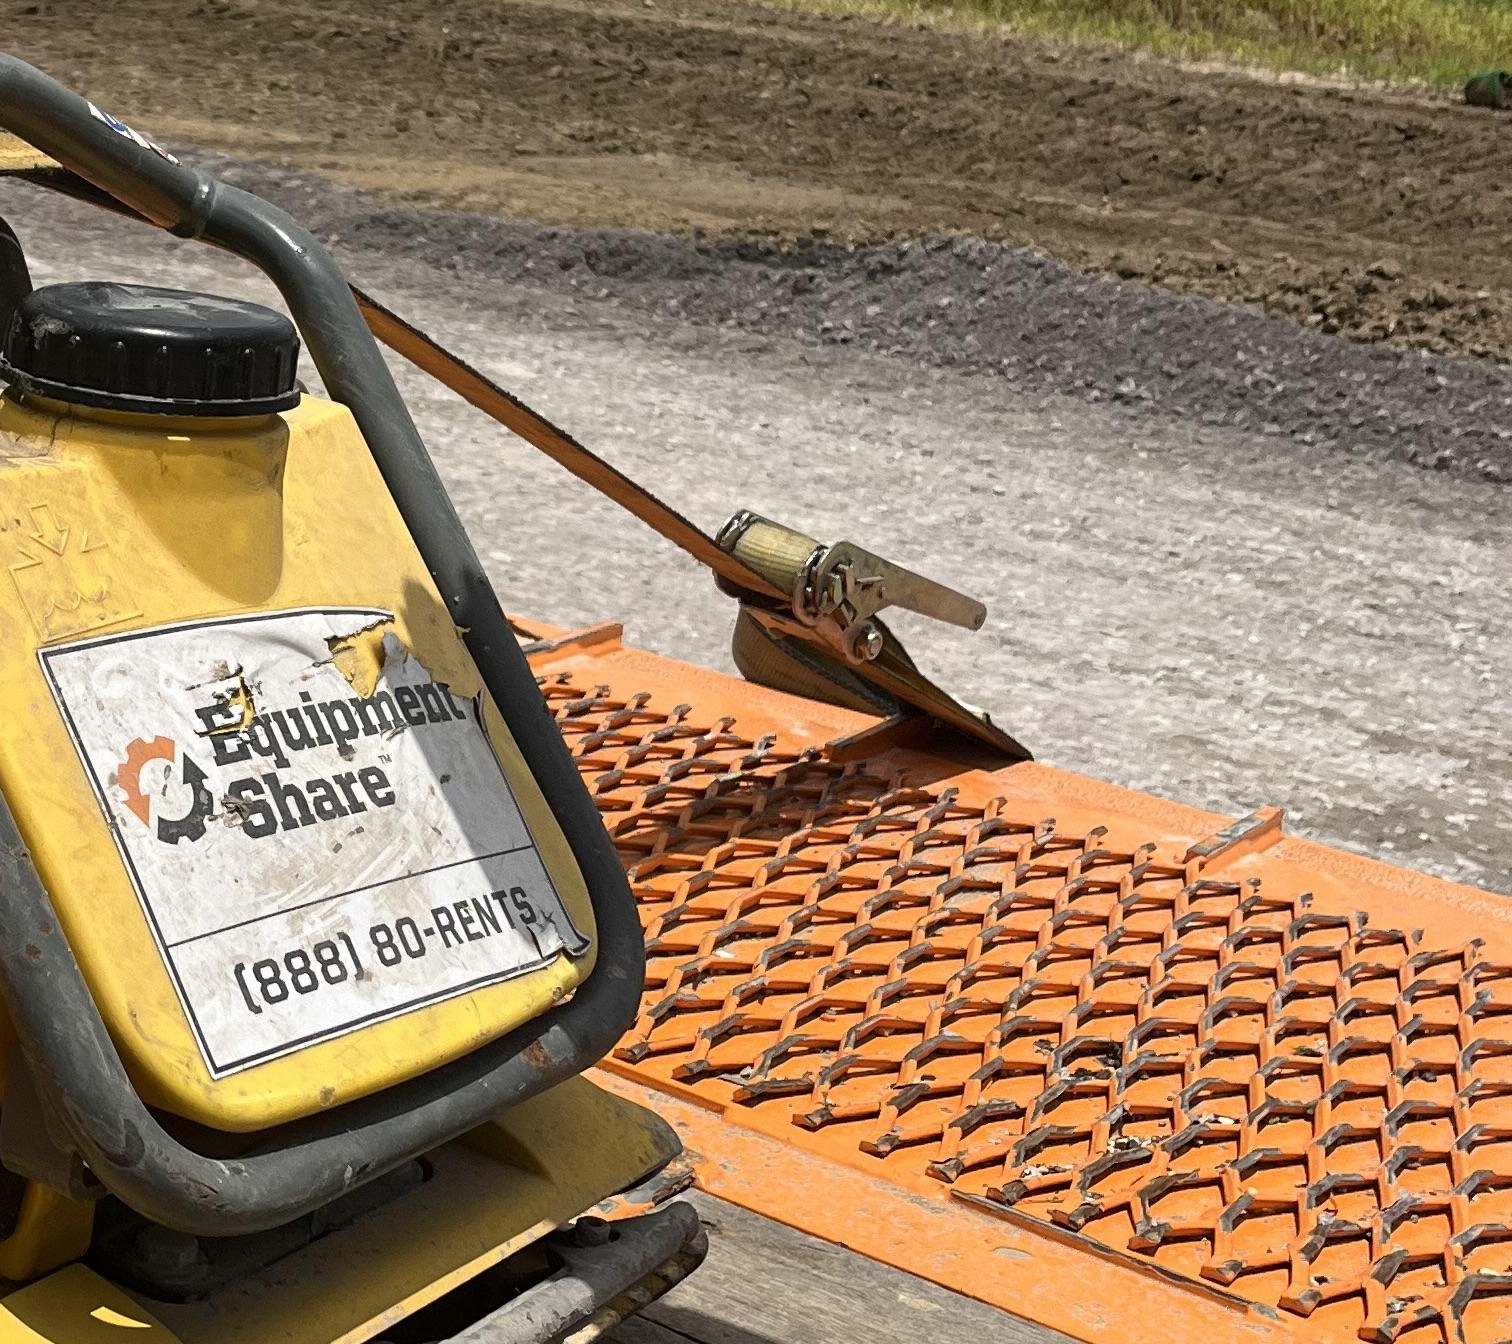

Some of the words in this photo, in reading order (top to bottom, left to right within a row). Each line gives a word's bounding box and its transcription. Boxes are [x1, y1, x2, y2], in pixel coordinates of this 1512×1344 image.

[195, 682, 467, 767] Equipment
[229, 765, 396, 838] Share
[233, 931, 363, 1015] (888)
[368, 885, 538, 970] 80-RENTS
